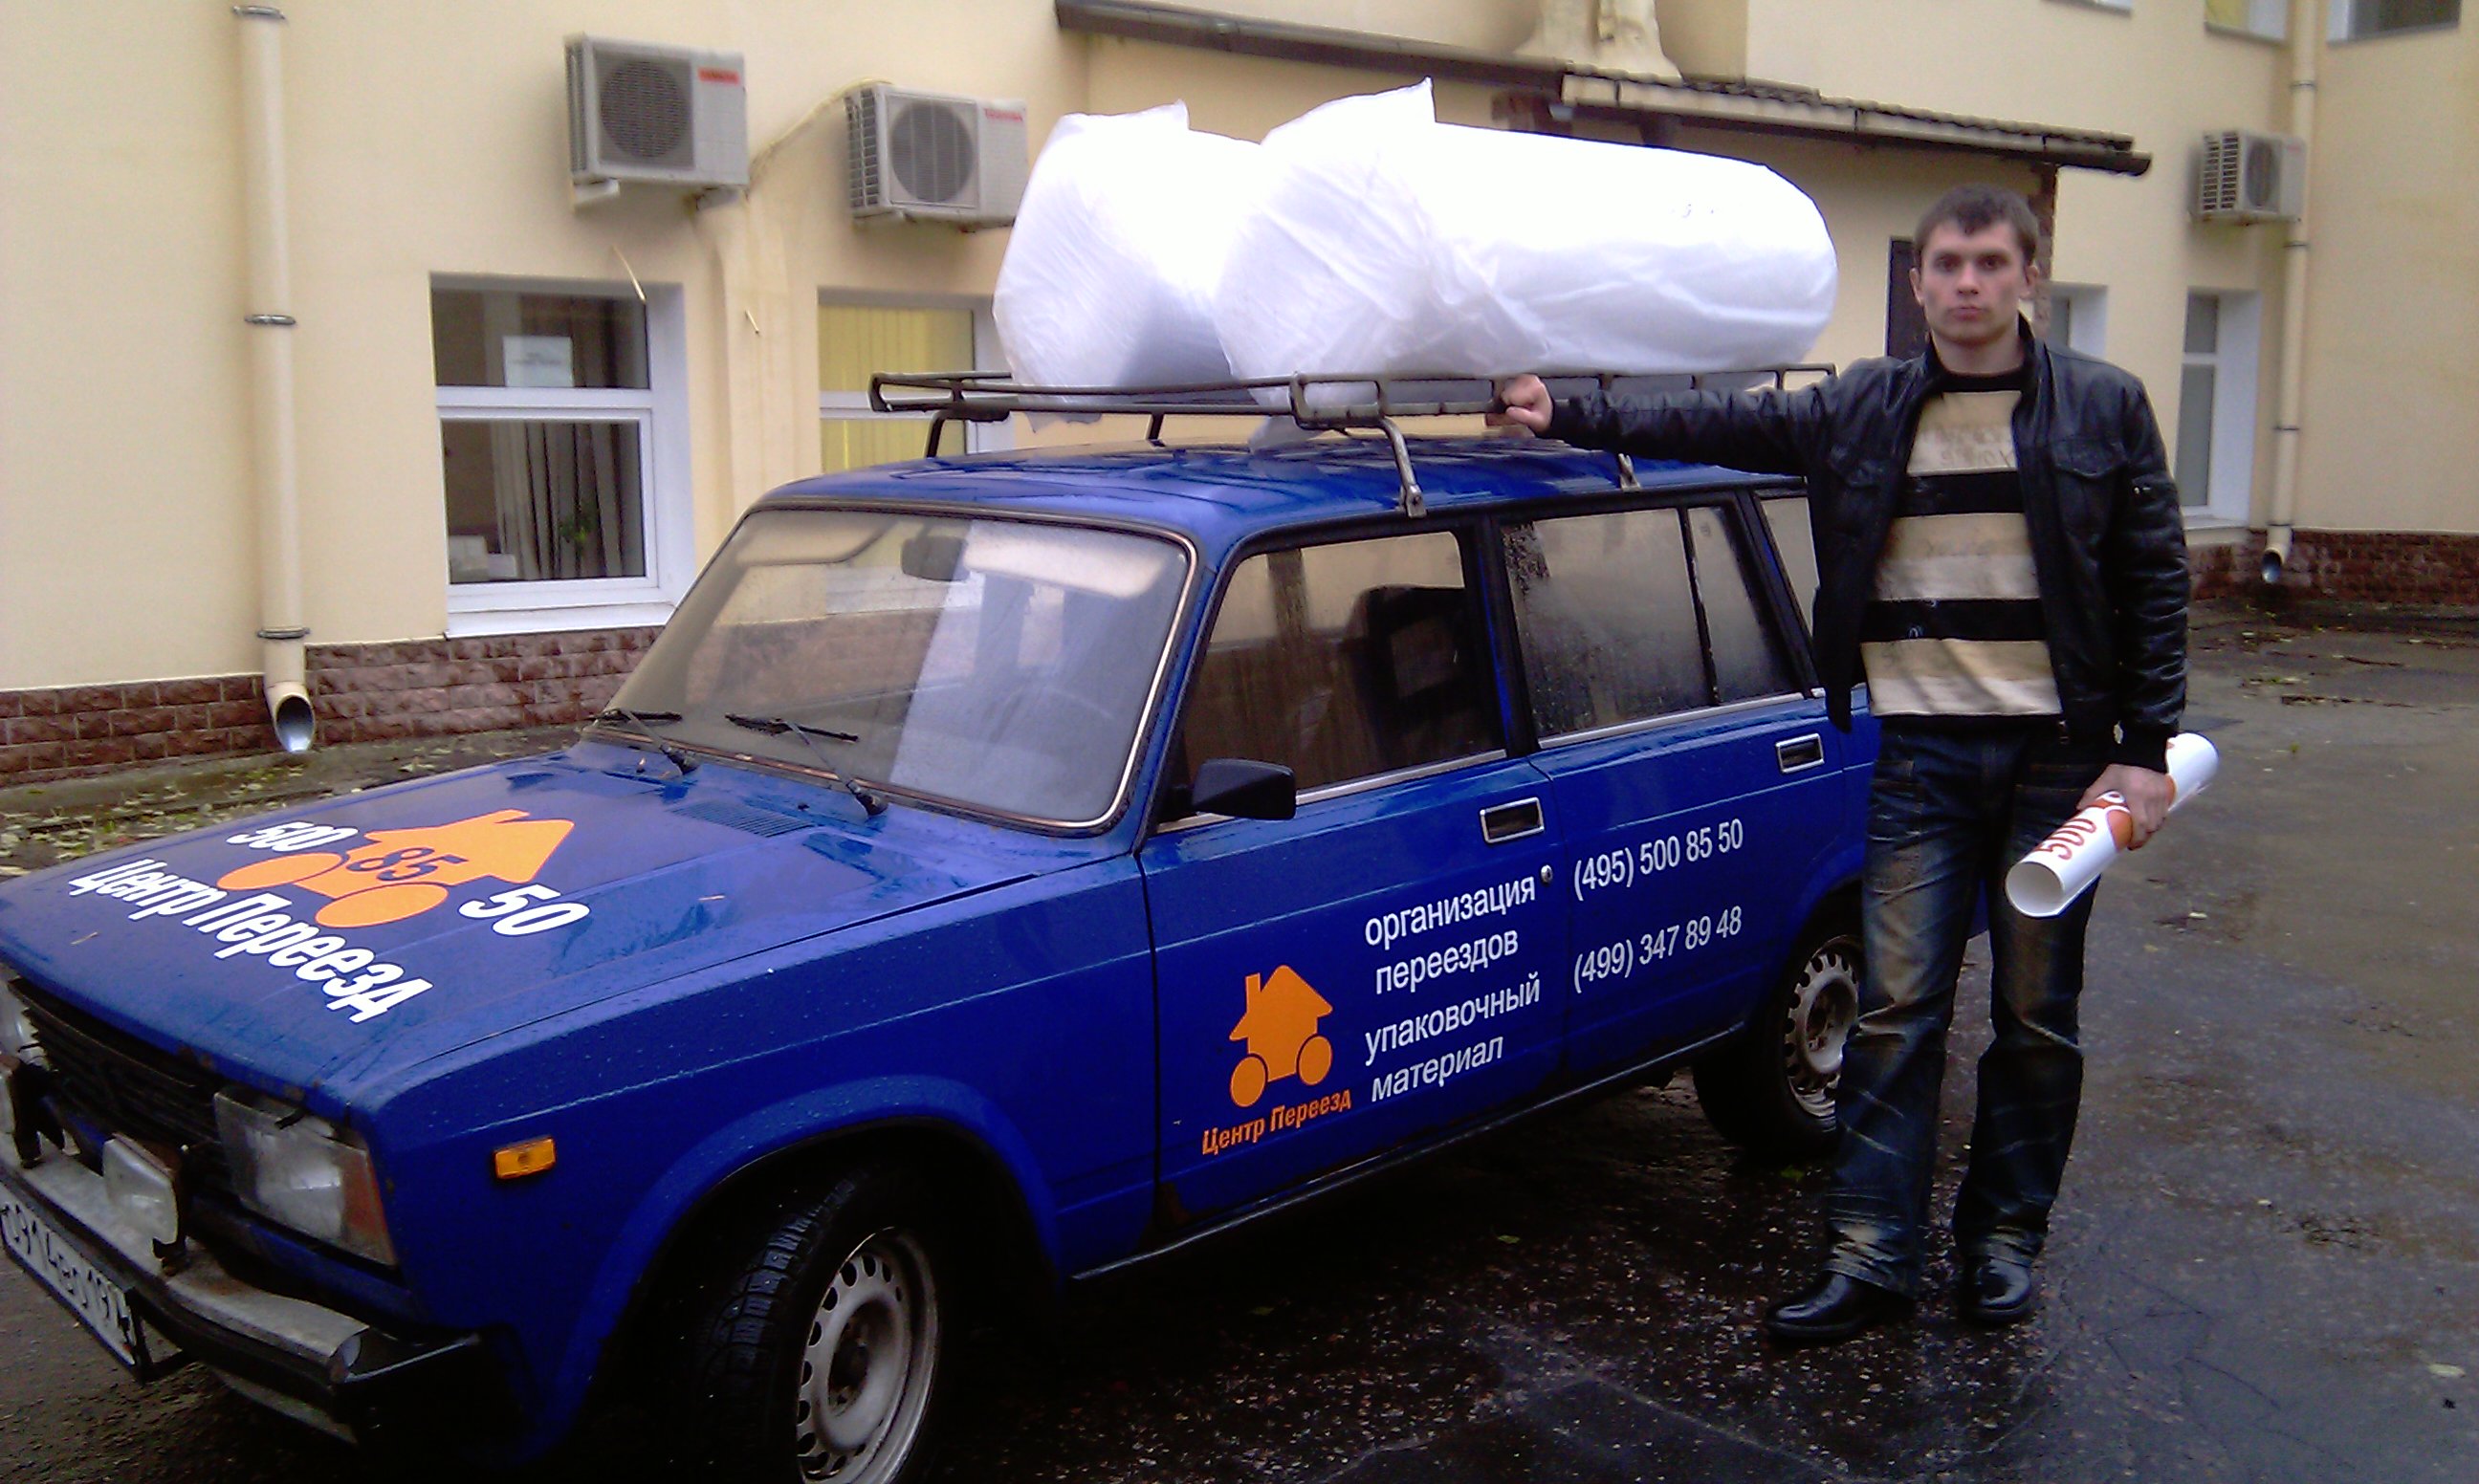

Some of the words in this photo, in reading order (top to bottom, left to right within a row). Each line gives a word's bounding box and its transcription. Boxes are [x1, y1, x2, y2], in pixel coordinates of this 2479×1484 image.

[226, 821, 359, 851] 500
[345, 847, 468, 881] 85
[1573, 847, 1634, 901] (495)
[1639, 836, 1680, 875] 500
[1685, 827, 1713, 862] 85
[1718, 818, 1744, 851] 50
[68, 859, 228, 921] Центр
[458, 884, 590, 936] 50
[1365, 875, 1536, 949] организация
[1375, 929, 1519, 993] переездов
[1573, 939, 1634, 993] (499)
[1639, 925, 1680, 966] 347
[1684, 916, 1712, 950] 89
[1717, 906, 1743, 938] 48
[1365, 971, 1541, 1066] упаковочный
[1371, 1036, 1504, 1102] материал
[1201, 1117, 1265, 1156] Центр
[1269, 1088, 1352, 1133] Переезд
